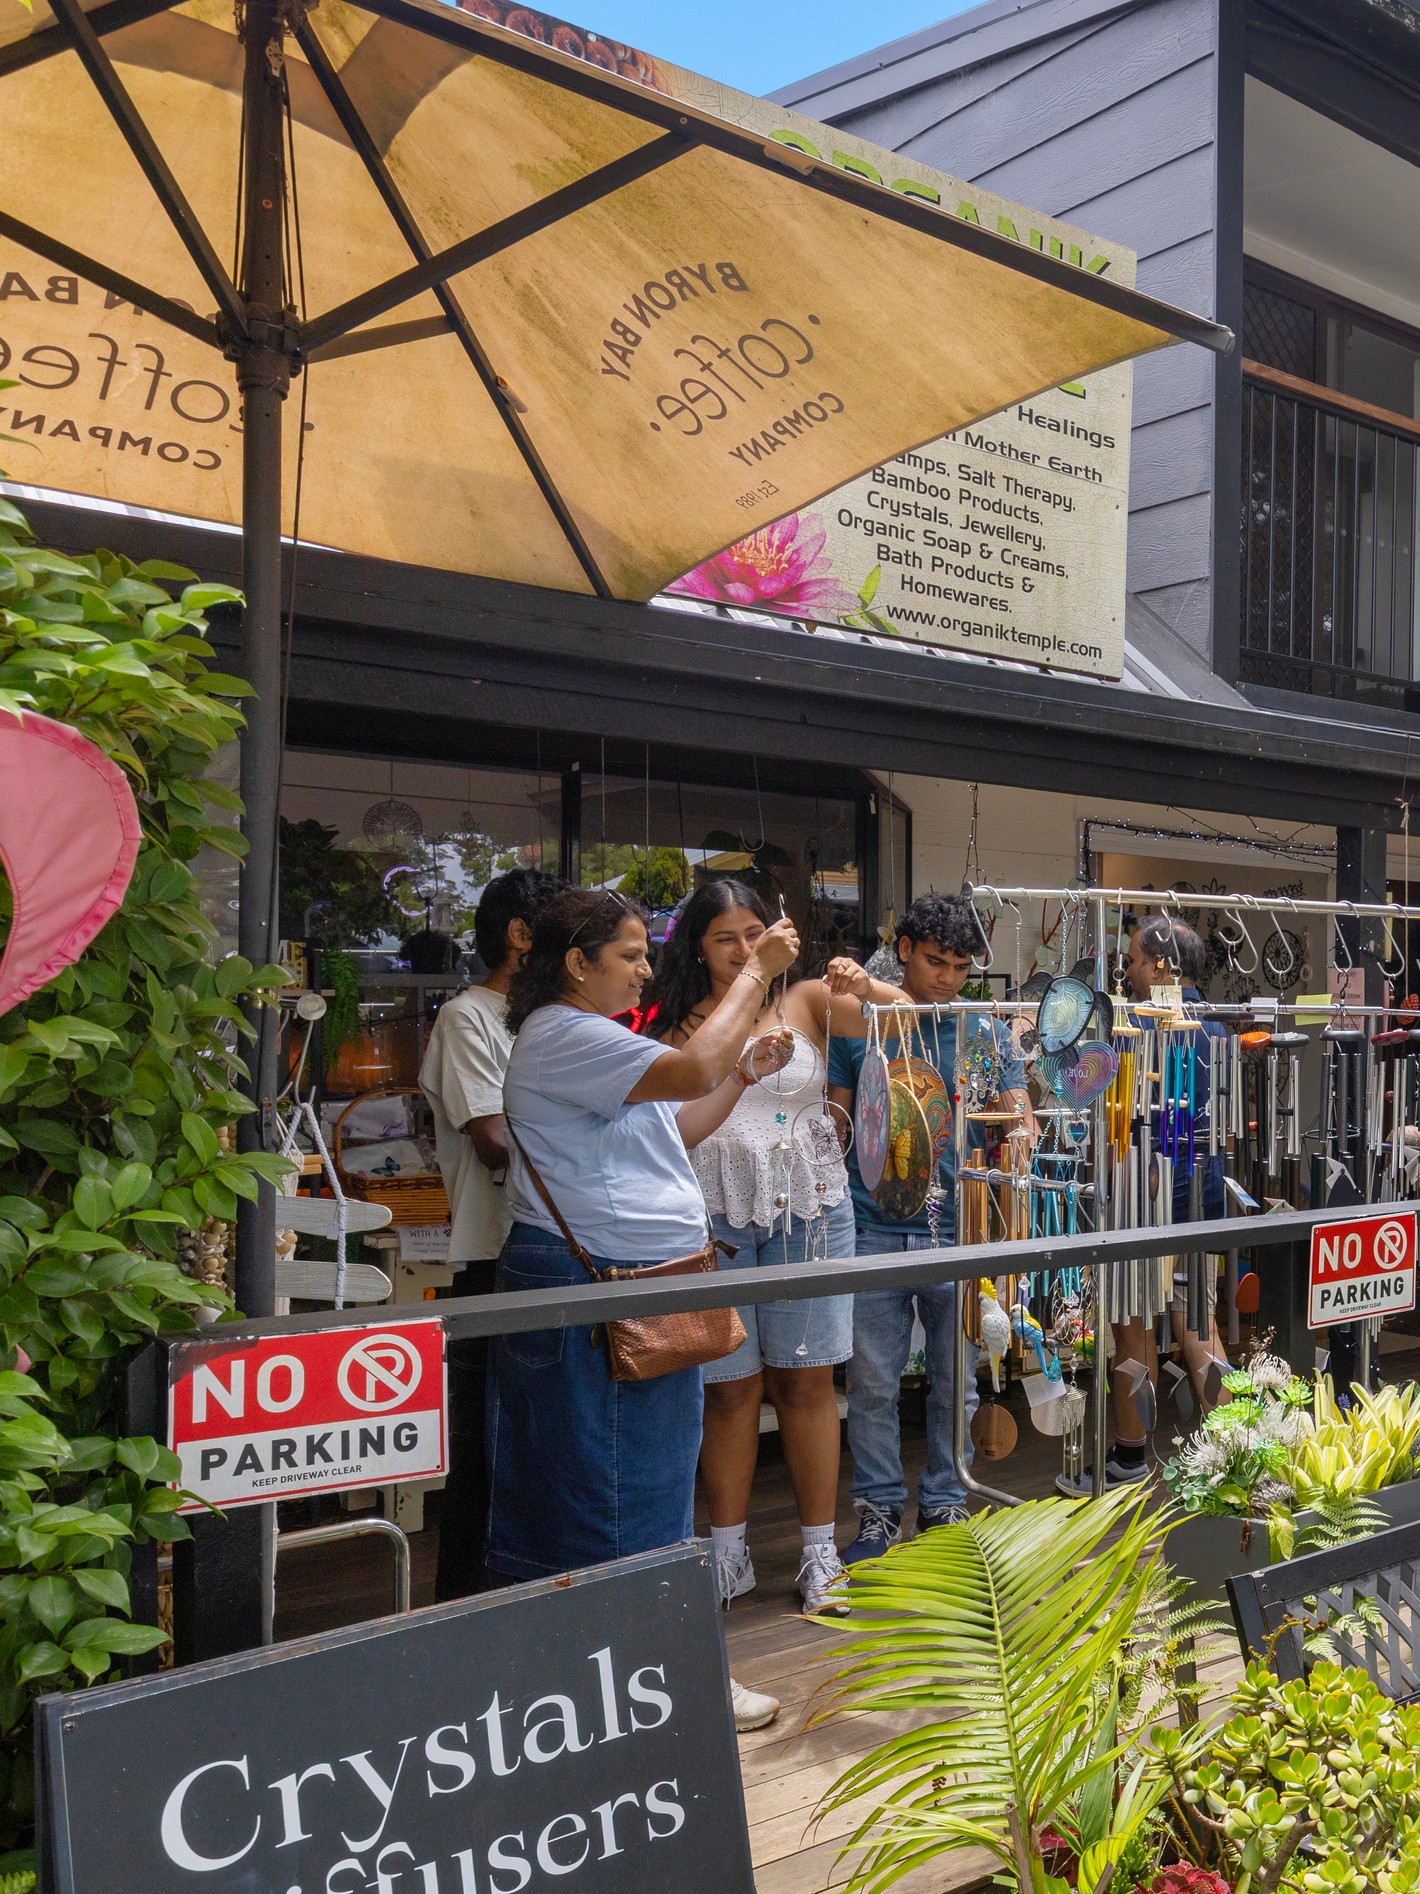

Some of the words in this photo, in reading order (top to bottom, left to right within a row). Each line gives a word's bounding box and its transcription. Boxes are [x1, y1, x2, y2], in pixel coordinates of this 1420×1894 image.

[1017, 405, 1116, 449] Healings
[893, 452, 950, 478] amps,
[957, 464, 996, 489] Salt
[1002, 474, 1077, 513] Therapy,
[964, 431, 1041, 465] Mother
[1048, 456, 1103, 483] Earth
[866, 490, 953, 528] Crystals,
[959, 514, 1046, 552] Jewellery,
[871, 466, 951, 501] Bamboo
[958, 488, 1044, 527] Products,
[837, 508, 915, 543] Organic
[922, 529, 972, 558] Soap
[978, 542, 994, 560] &
[1000, 548, 1069, 580] Creams,
[876, 543, 923, 569] Bath
[930, 556, 1015, 589] Products
[1021, 577, 1036, 594] &
[900, 574, 1013, 614] Homewares.
[886, 604, 1103, 660] www.organiktemple.com
[1318, 1233, 1362, 1274] NO
[1320, 1276, 1405, 1310] PARKING
[1339, 1306, 1350, 1314] KEEP
[1350, 1303, 1369, 1312] DRIVEWAY
[191, 1354, 305, 1424] NO
[201, 1421, 419, 1481] PARKING
[251, 1475, 279, 1488] KEEP
[280, 1468, 330, 1485] DRIVEWAY
[331, 1464, 362, 1477] CLEAR
[160, 1646, 674, 1873] Crystals
